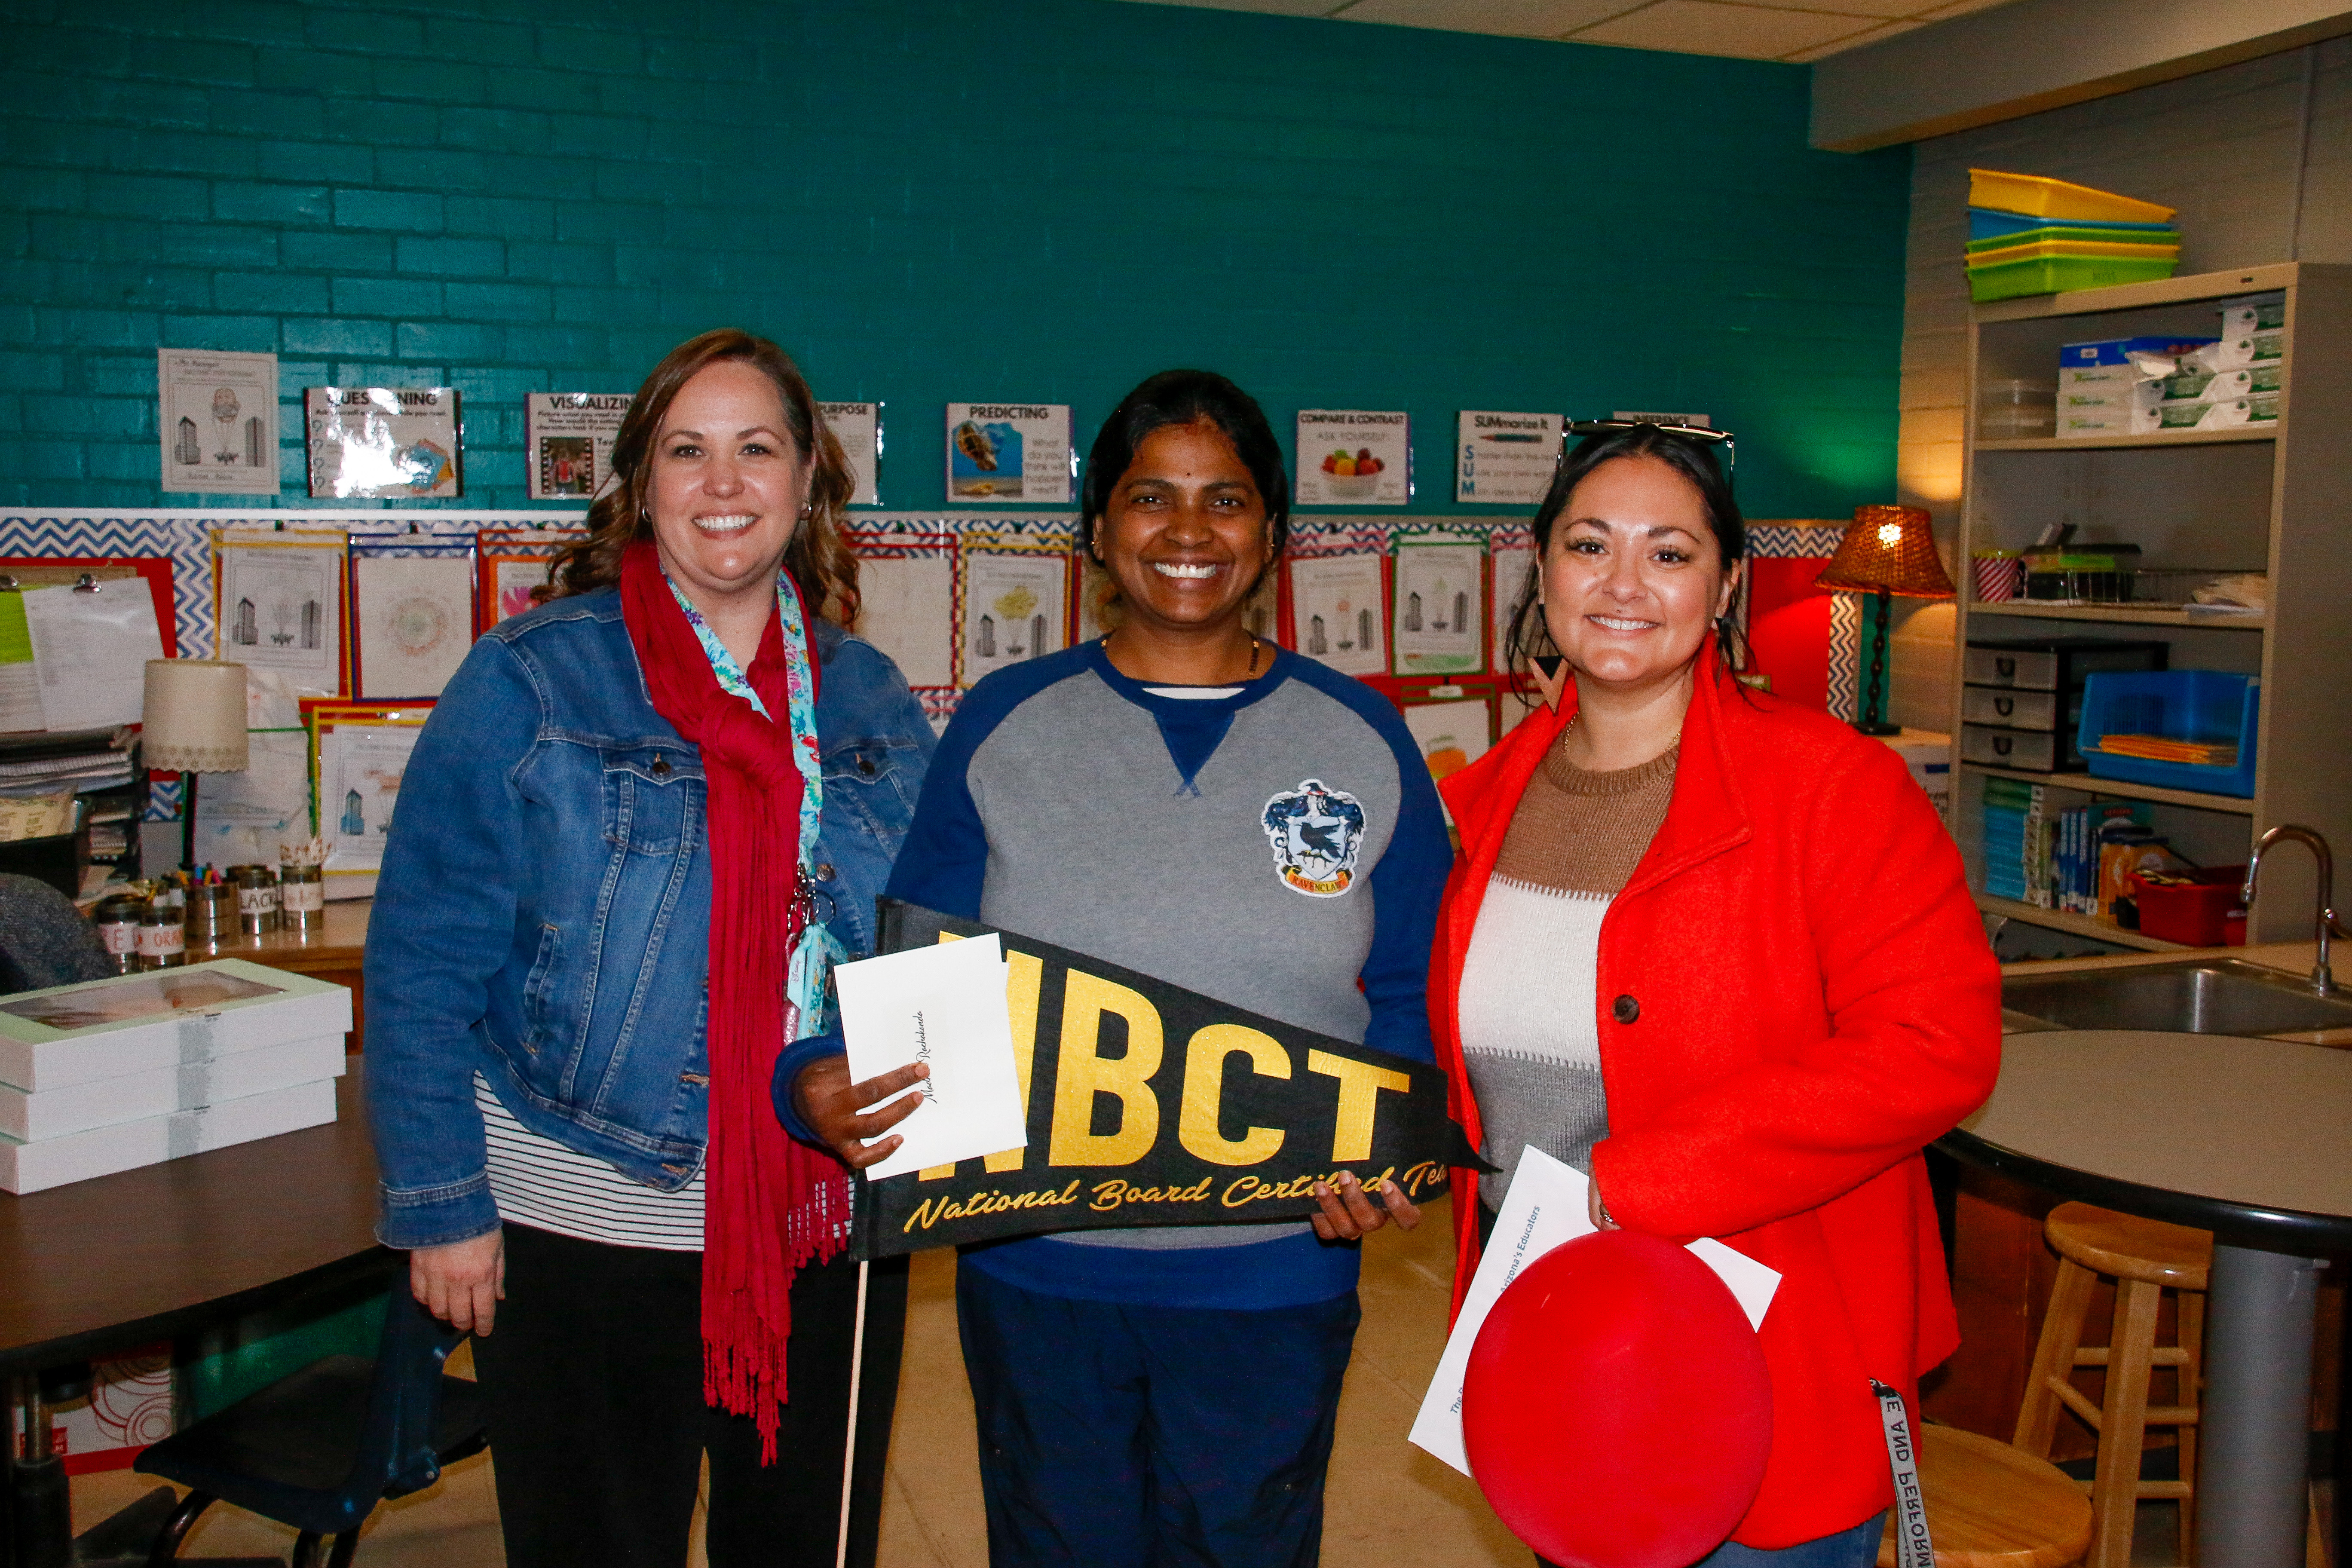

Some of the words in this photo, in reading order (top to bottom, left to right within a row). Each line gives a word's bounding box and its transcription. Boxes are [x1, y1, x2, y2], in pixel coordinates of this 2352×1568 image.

[328, 390, 437, 406] UESNING
[969, 407, 1049, 419] PREDICTING
[1300, 413, 1345, 424] COMPARE
[1348, 415, 1354, 424] &
[1357, 415, 1404, 424] CONTRAST
[1292, 876, 1341, 893] RAVENCLAW
[919, 931, 1409, 1181] NBCT
[904, 1179, 1081, 1234] National
[1089, 1176, 1213, 1211] Board
[1222, 1166, 1396, 1208] Certifid
[1517, 1205, 1541, 1251] Educators
